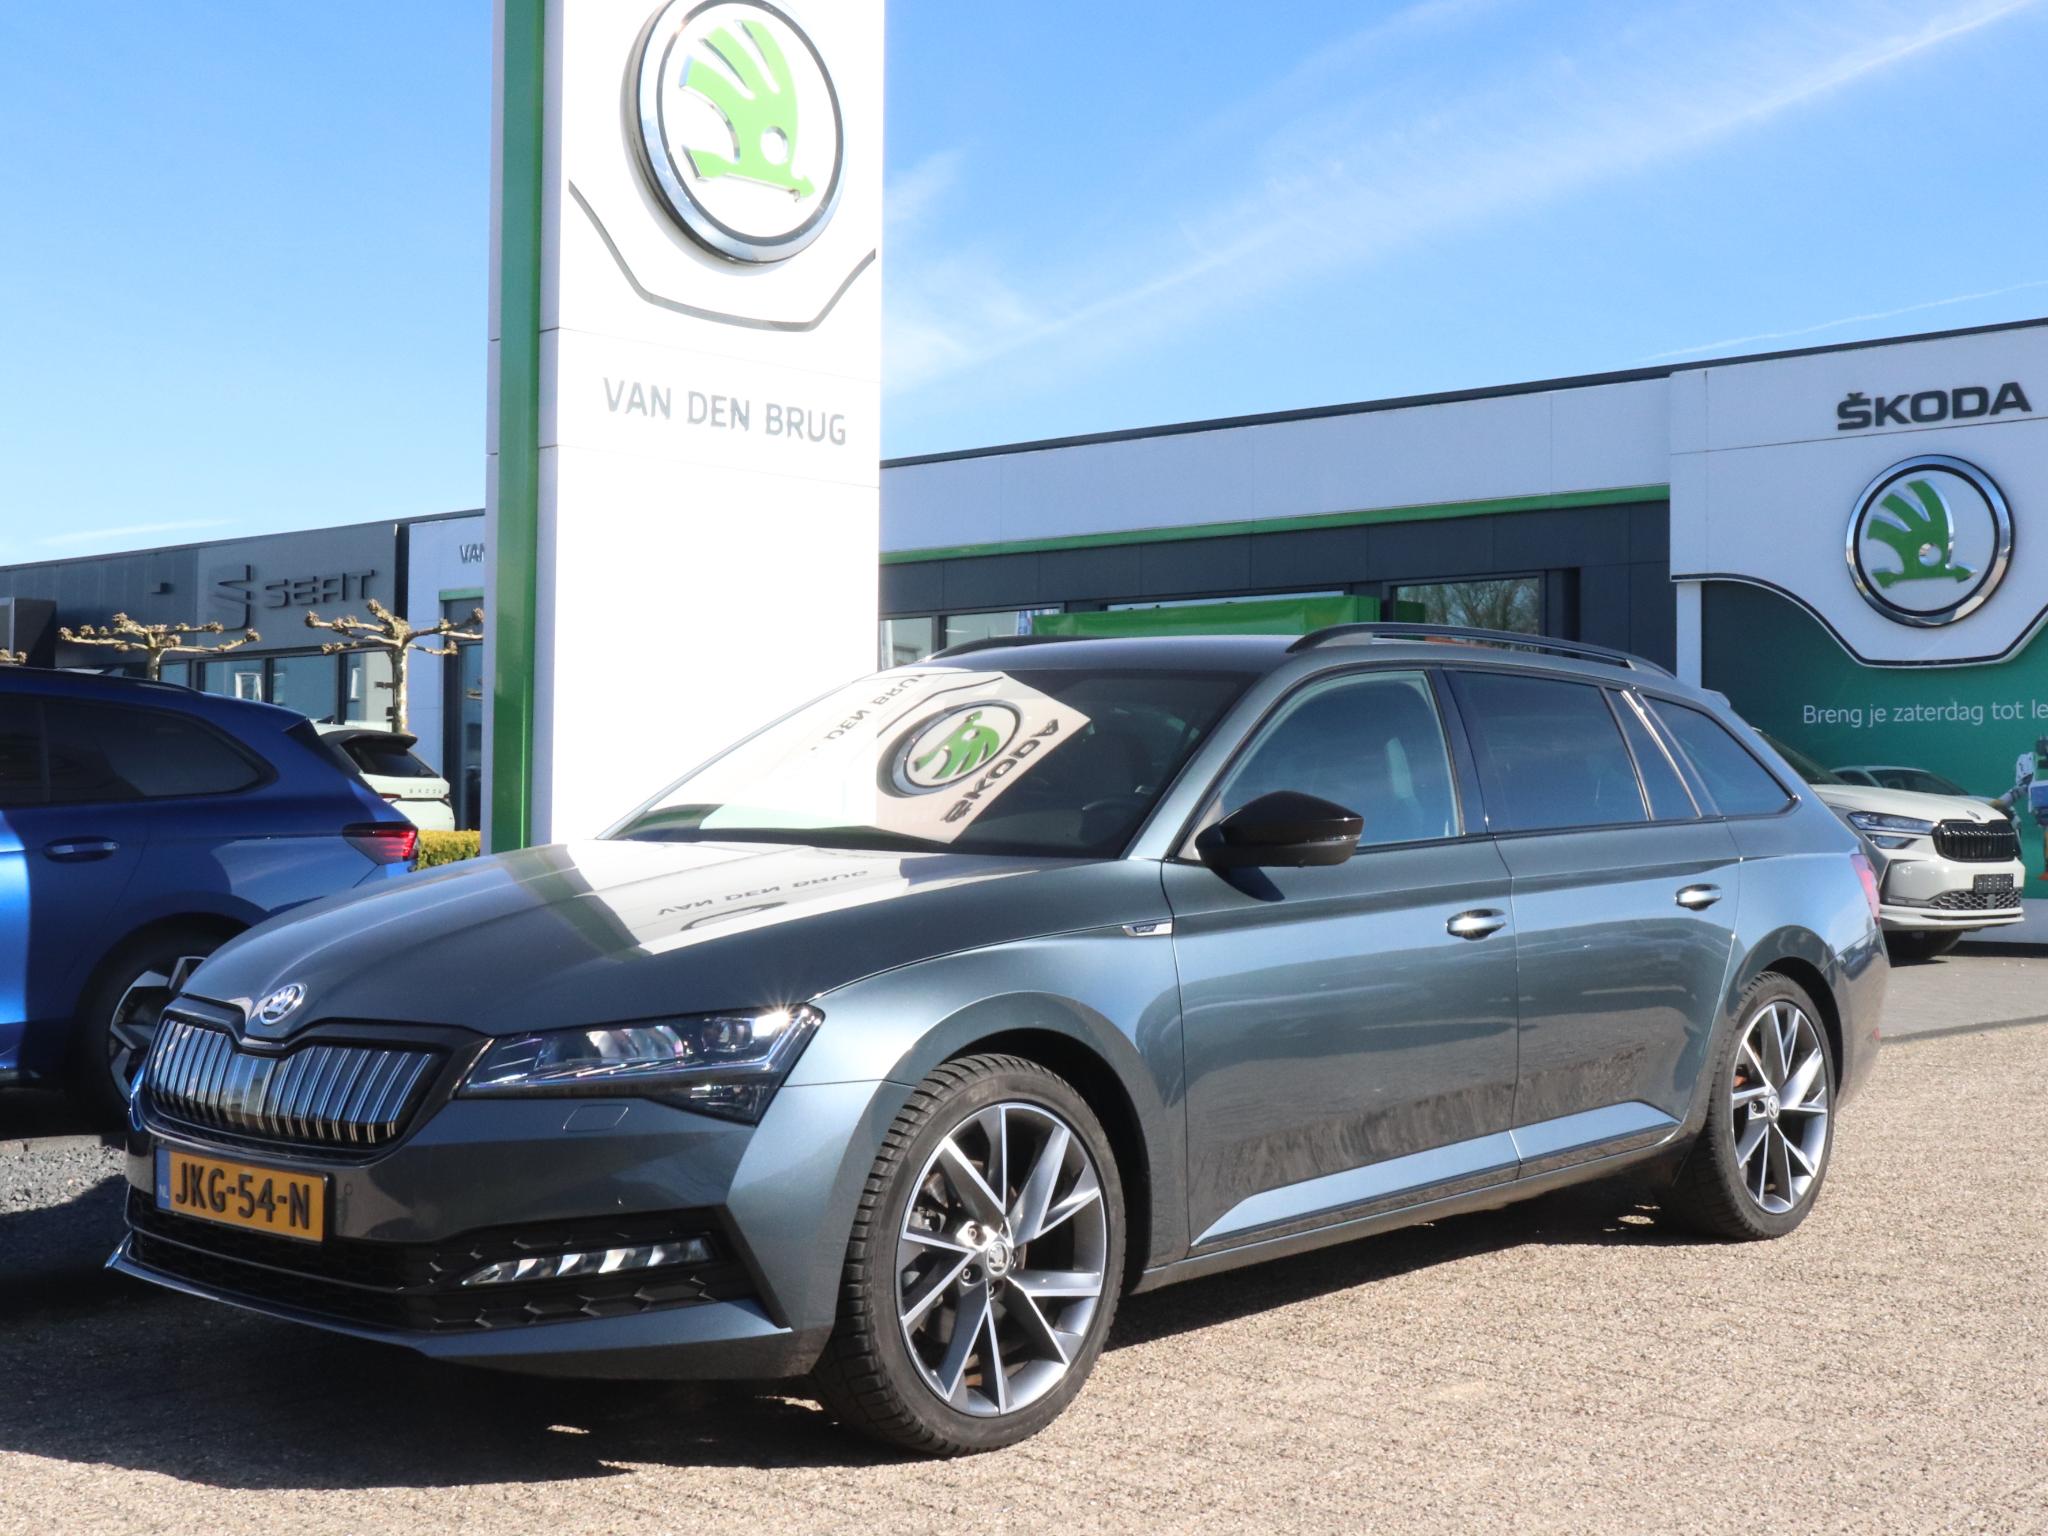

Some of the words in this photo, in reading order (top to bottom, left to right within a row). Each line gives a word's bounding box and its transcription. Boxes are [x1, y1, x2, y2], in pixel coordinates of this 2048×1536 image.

[603, 376, 671, 420] VAN
[687, 390, 750, 432] DEN
[765, 402, 847, 446] BRUG
[1837, 381, 2033, 431] ŠKODA
[264, 568, 376, 609] SEAT
[1803, 704, 1862, 729] Breng
[1867, 703, 1887, 728] je
[1892, 699, 1984, 726] zaterdag
[1991, 701, 2025, 721] tot
[174, 1161, 311, 1231] JKG-54-N
